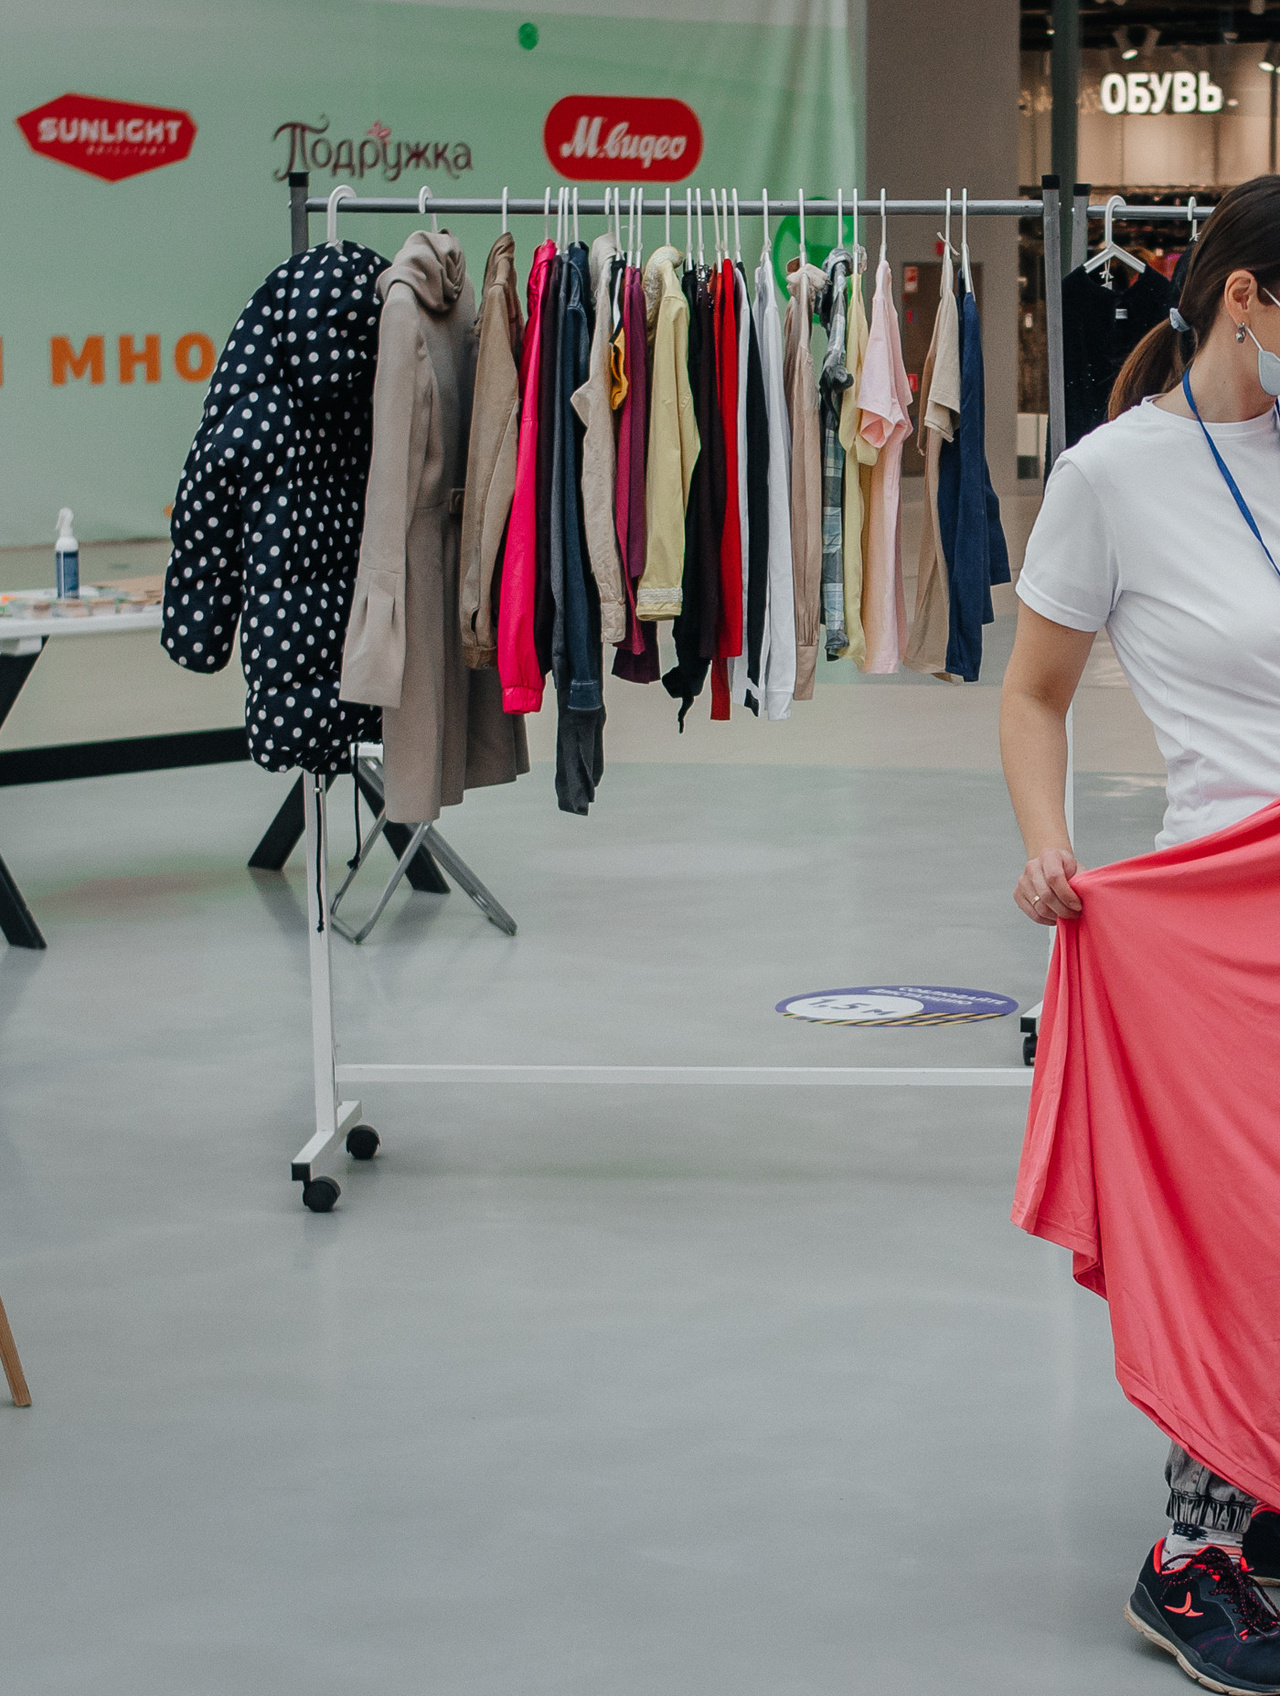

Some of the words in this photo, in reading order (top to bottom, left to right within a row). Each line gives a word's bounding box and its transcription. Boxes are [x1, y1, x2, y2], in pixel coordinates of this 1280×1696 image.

[1101, 71, 1223, 115] ОБУВЬ
[38, 116, 182, 145] SUNLIGHT
[273, 114, 474, 182] Подружка
